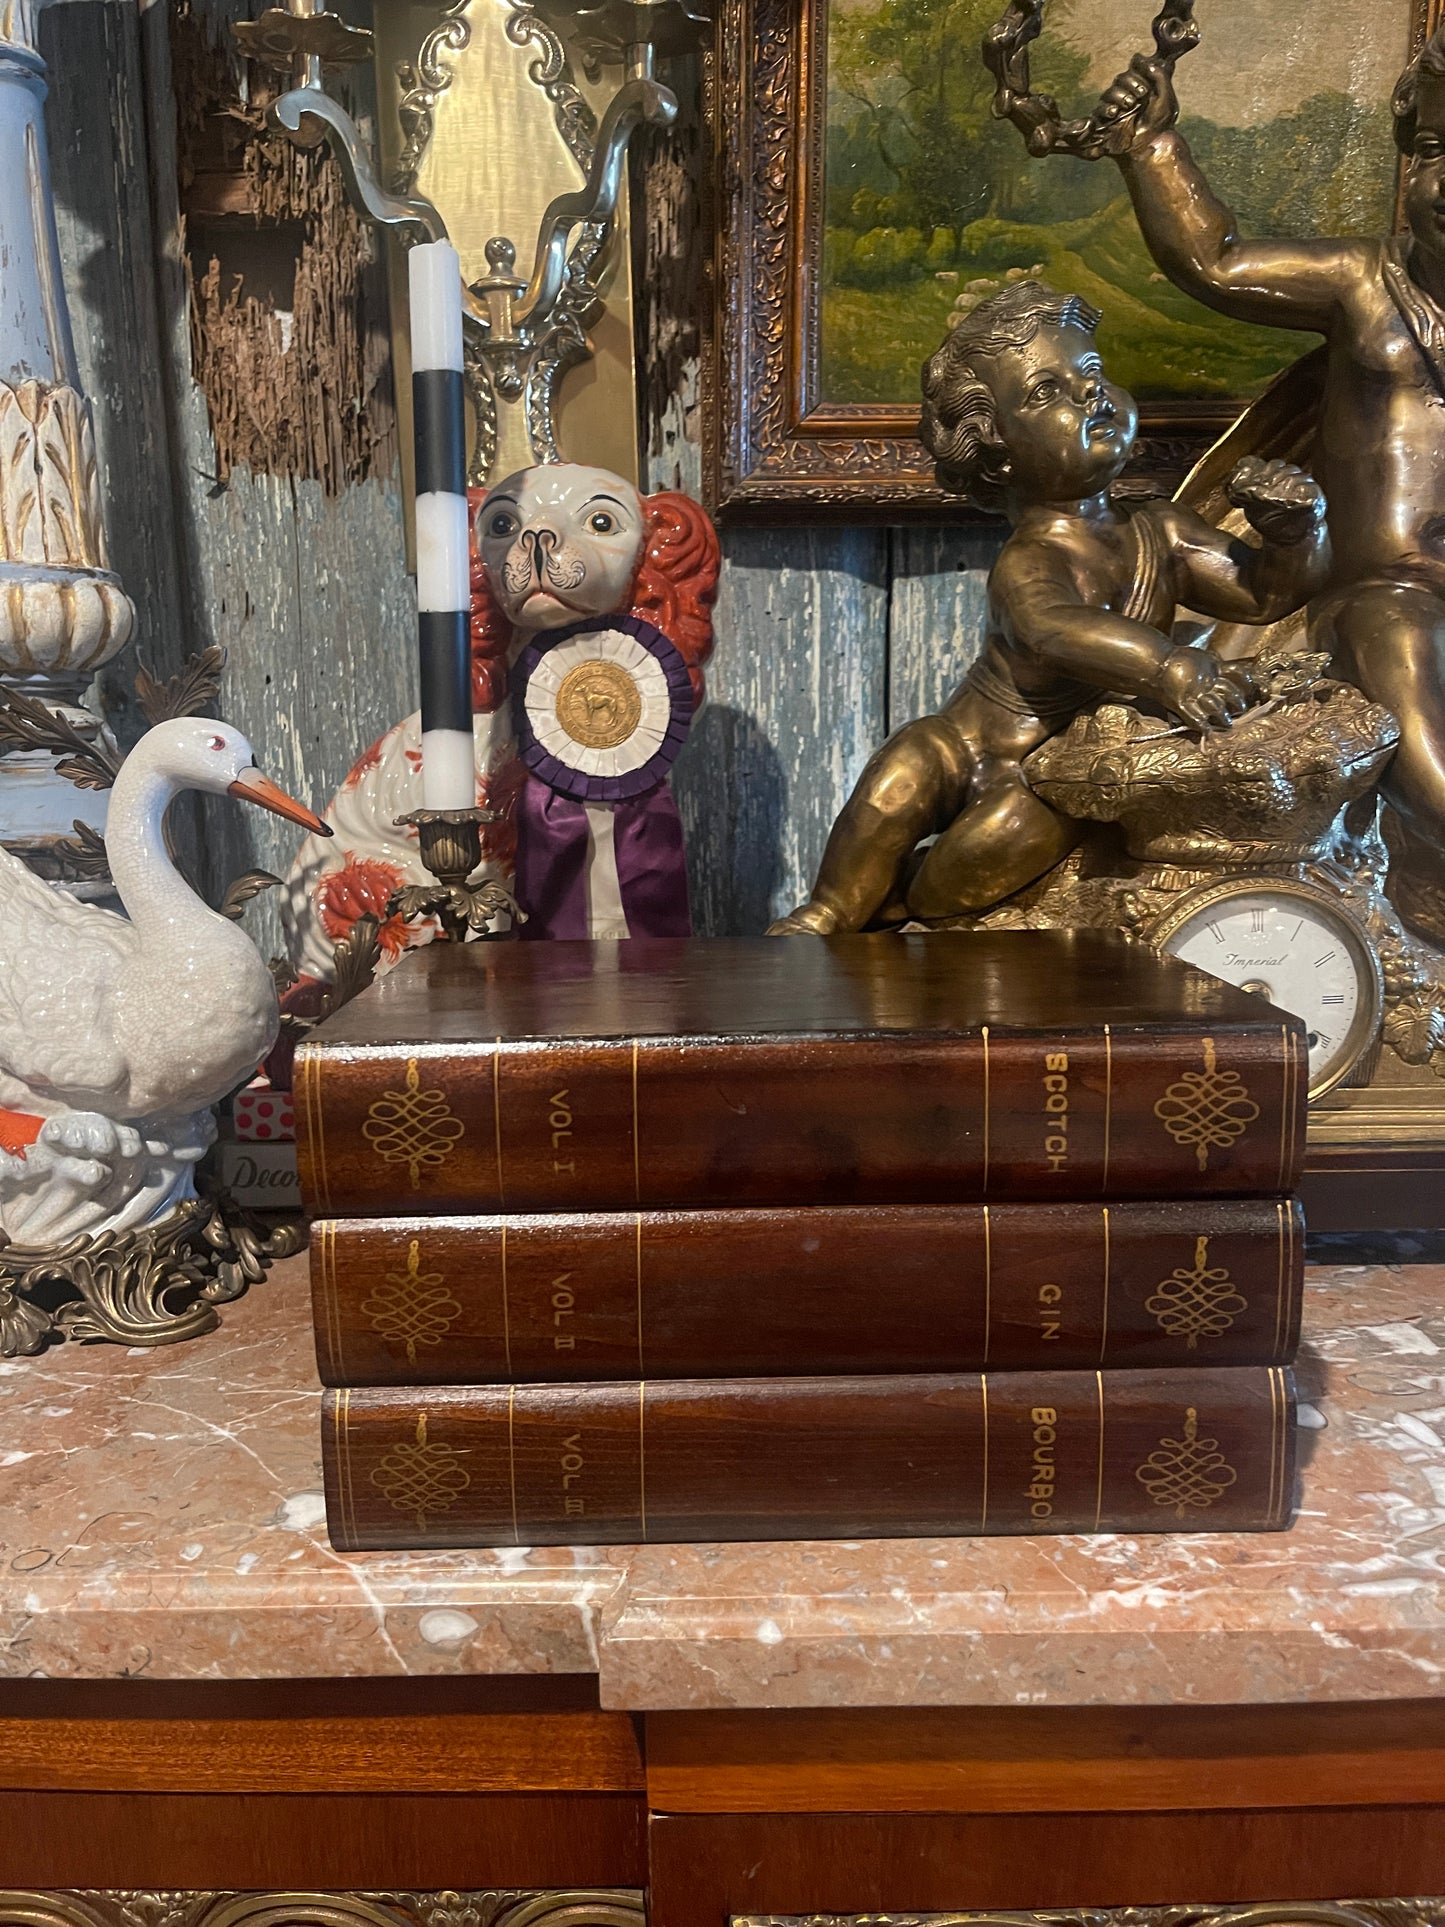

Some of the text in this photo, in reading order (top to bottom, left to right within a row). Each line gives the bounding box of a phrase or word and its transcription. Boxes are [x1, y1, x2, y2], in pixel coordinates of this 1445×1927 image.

[1222, 952, 1289, 970] Imperial
[549, 1089, 576, 1178] VOL I
[1042, 1053, 1069, 1173] SCOTCH
[551, 1271, 576, 1350] VOL II
[1039, 1283, 1062, 1340] GIN
[561, 1433, 585, 1515] VOL III
